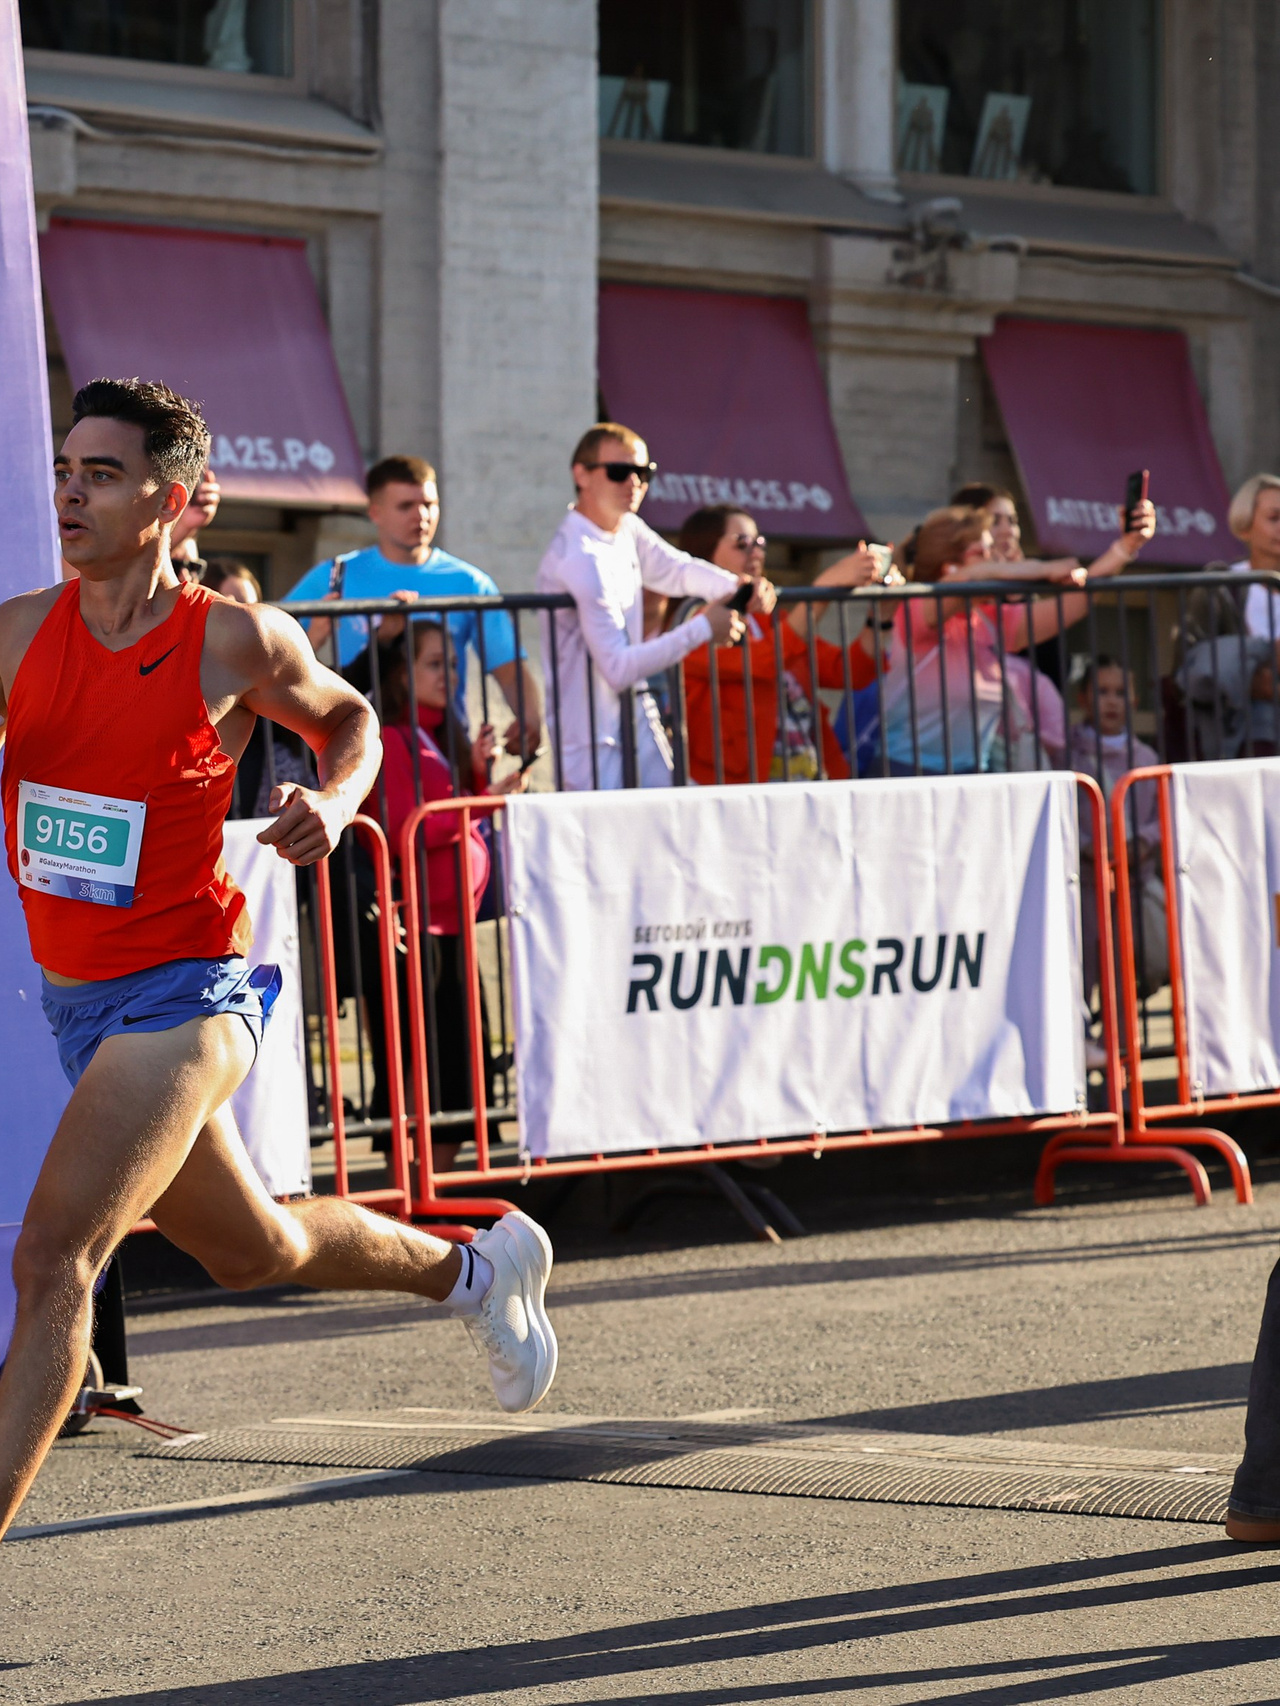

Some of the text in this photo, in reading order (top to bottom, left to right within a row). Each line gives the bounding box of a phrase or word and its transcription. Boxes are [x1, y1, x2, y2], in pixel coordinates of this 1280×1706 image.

[35, 815, 109, 854] 9156
[39, 857, 96, 875] #GalaxyMarathon
[79, 882, 116, 901] 3km
[634, 918, 753, 943] БЕГОВОЙ КЛУБ
[626, 931, 985, 1014] RUNDNSRUN
